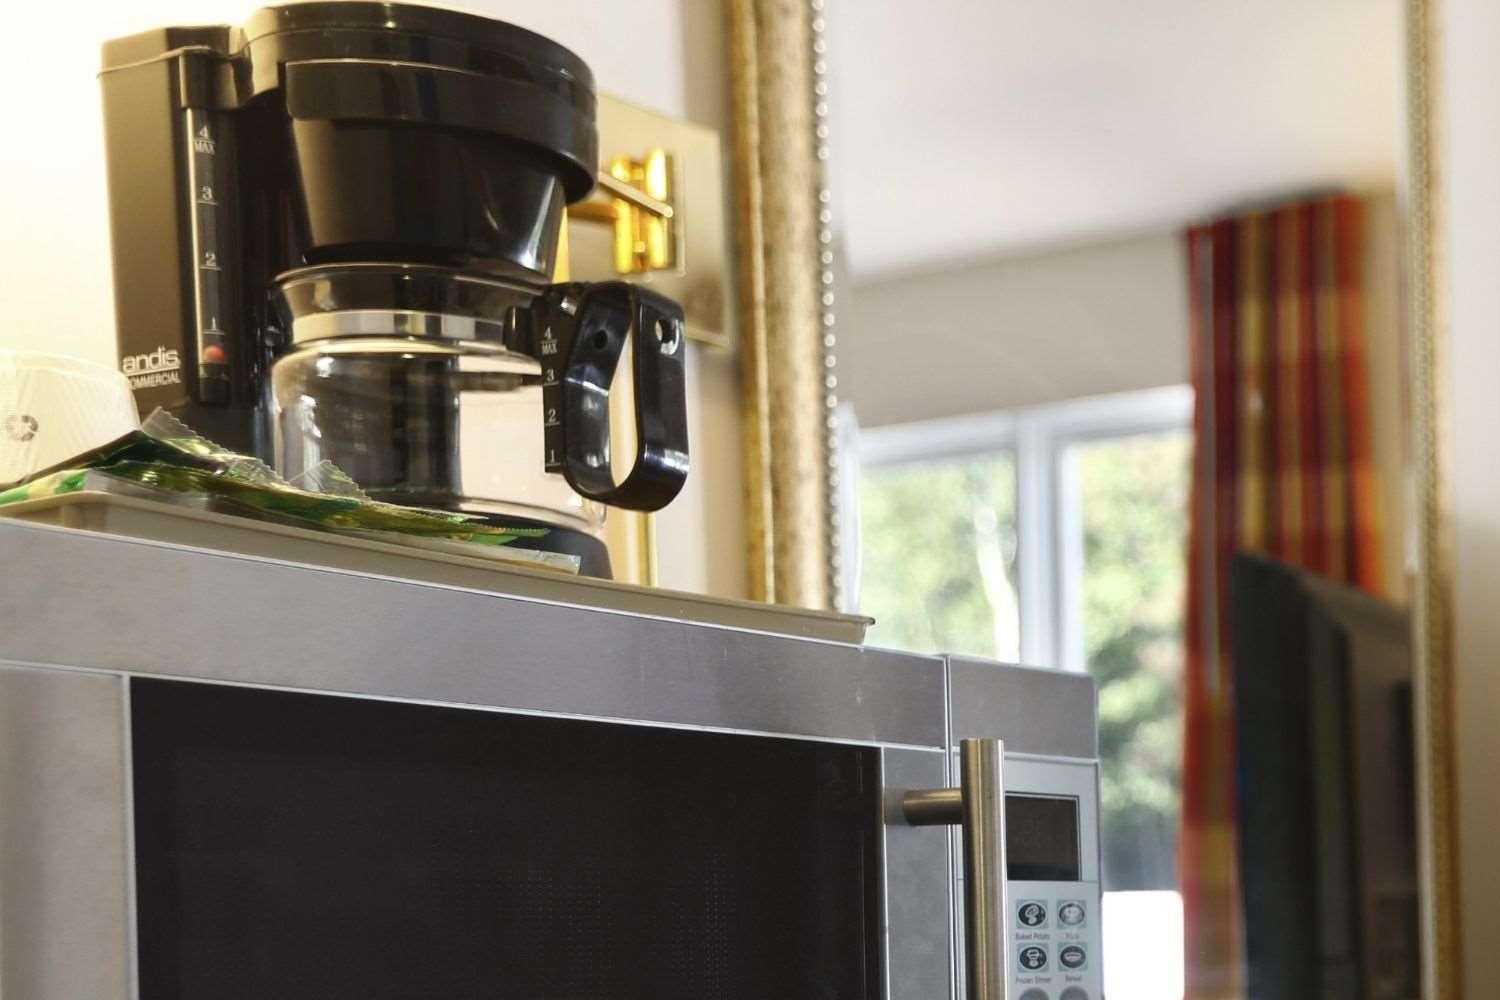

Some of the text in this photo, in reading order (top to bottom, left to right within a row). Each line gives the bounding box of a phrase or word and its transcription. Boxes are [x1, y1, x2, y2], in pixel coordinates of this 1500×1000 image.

[199, 125, 209, 139] 4
[194, 141, 216, 155] MAX
[201, 185, 213, 200] 3
[204, 252, 217, 267] 2
[544, 326, 552, 340] 4
[541, 341, 558, 355] MAX
[122, 344, 180, 373] andis
[546, 367, 555, 382] 3
[548, 407, 557, 424] 2
